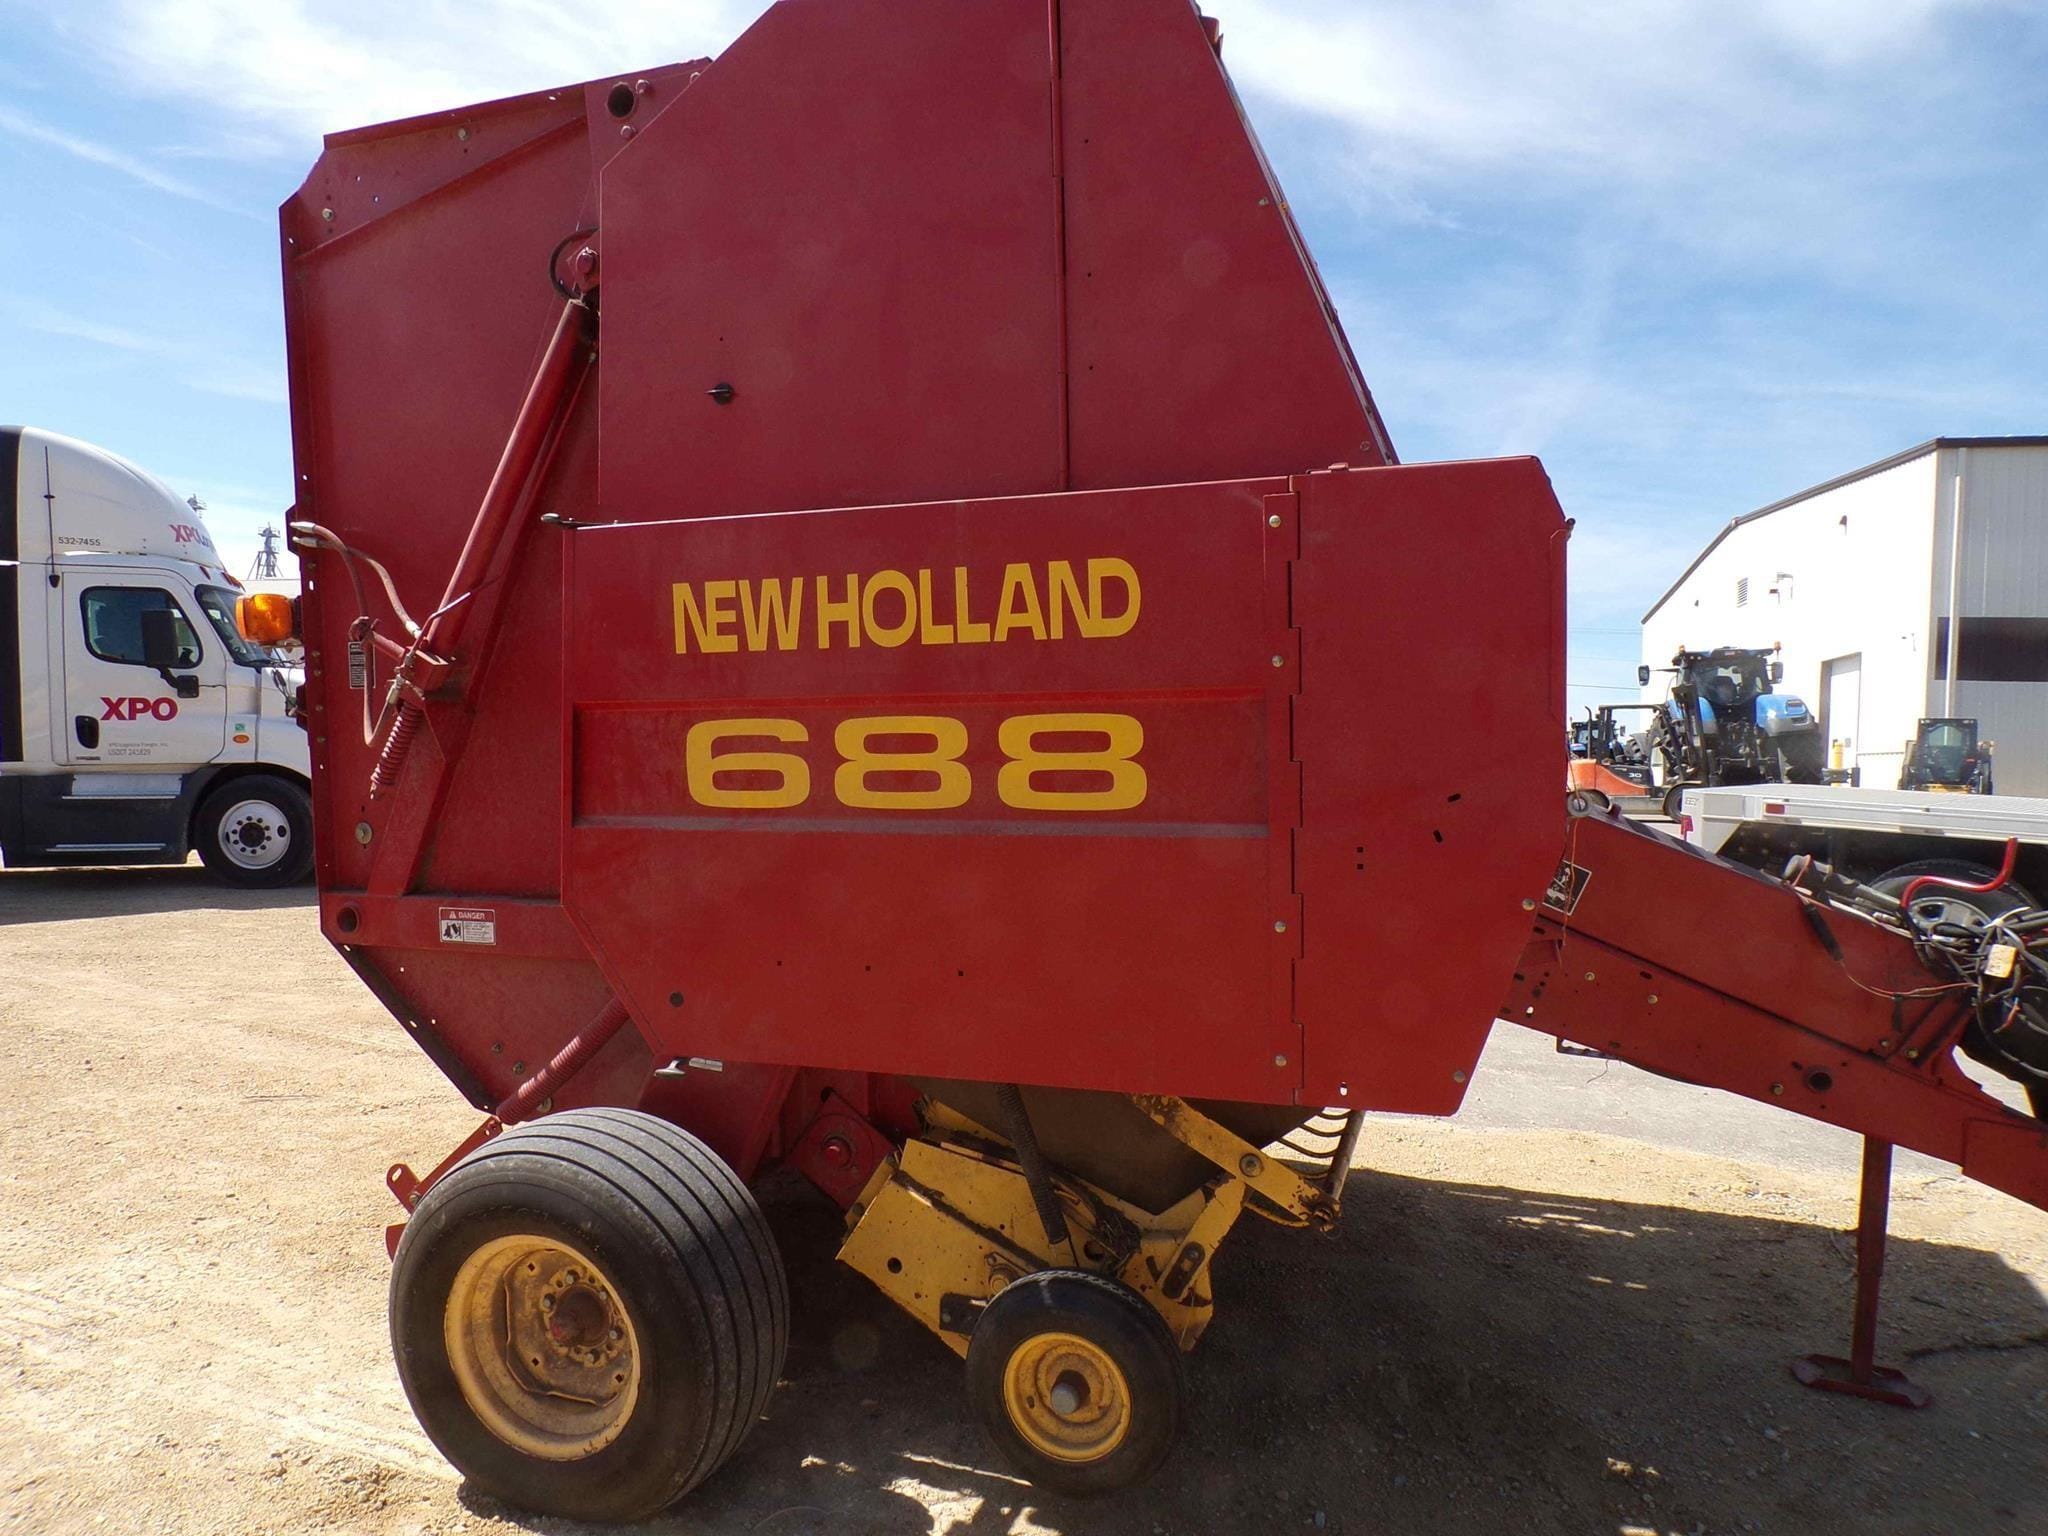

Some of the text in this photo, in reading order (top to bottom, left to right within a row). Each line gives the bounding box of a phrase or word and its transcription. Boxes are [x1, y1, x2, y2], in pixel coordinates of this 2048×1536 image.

[58, 536, 101, 546] 532-7455
[672, 557, 1142, 654] NEW HOLLAND
[100, 697, 178, 721] XPO
[686, 712, 1148, 811] 688
[458, 911, 486, 920] DANGER
